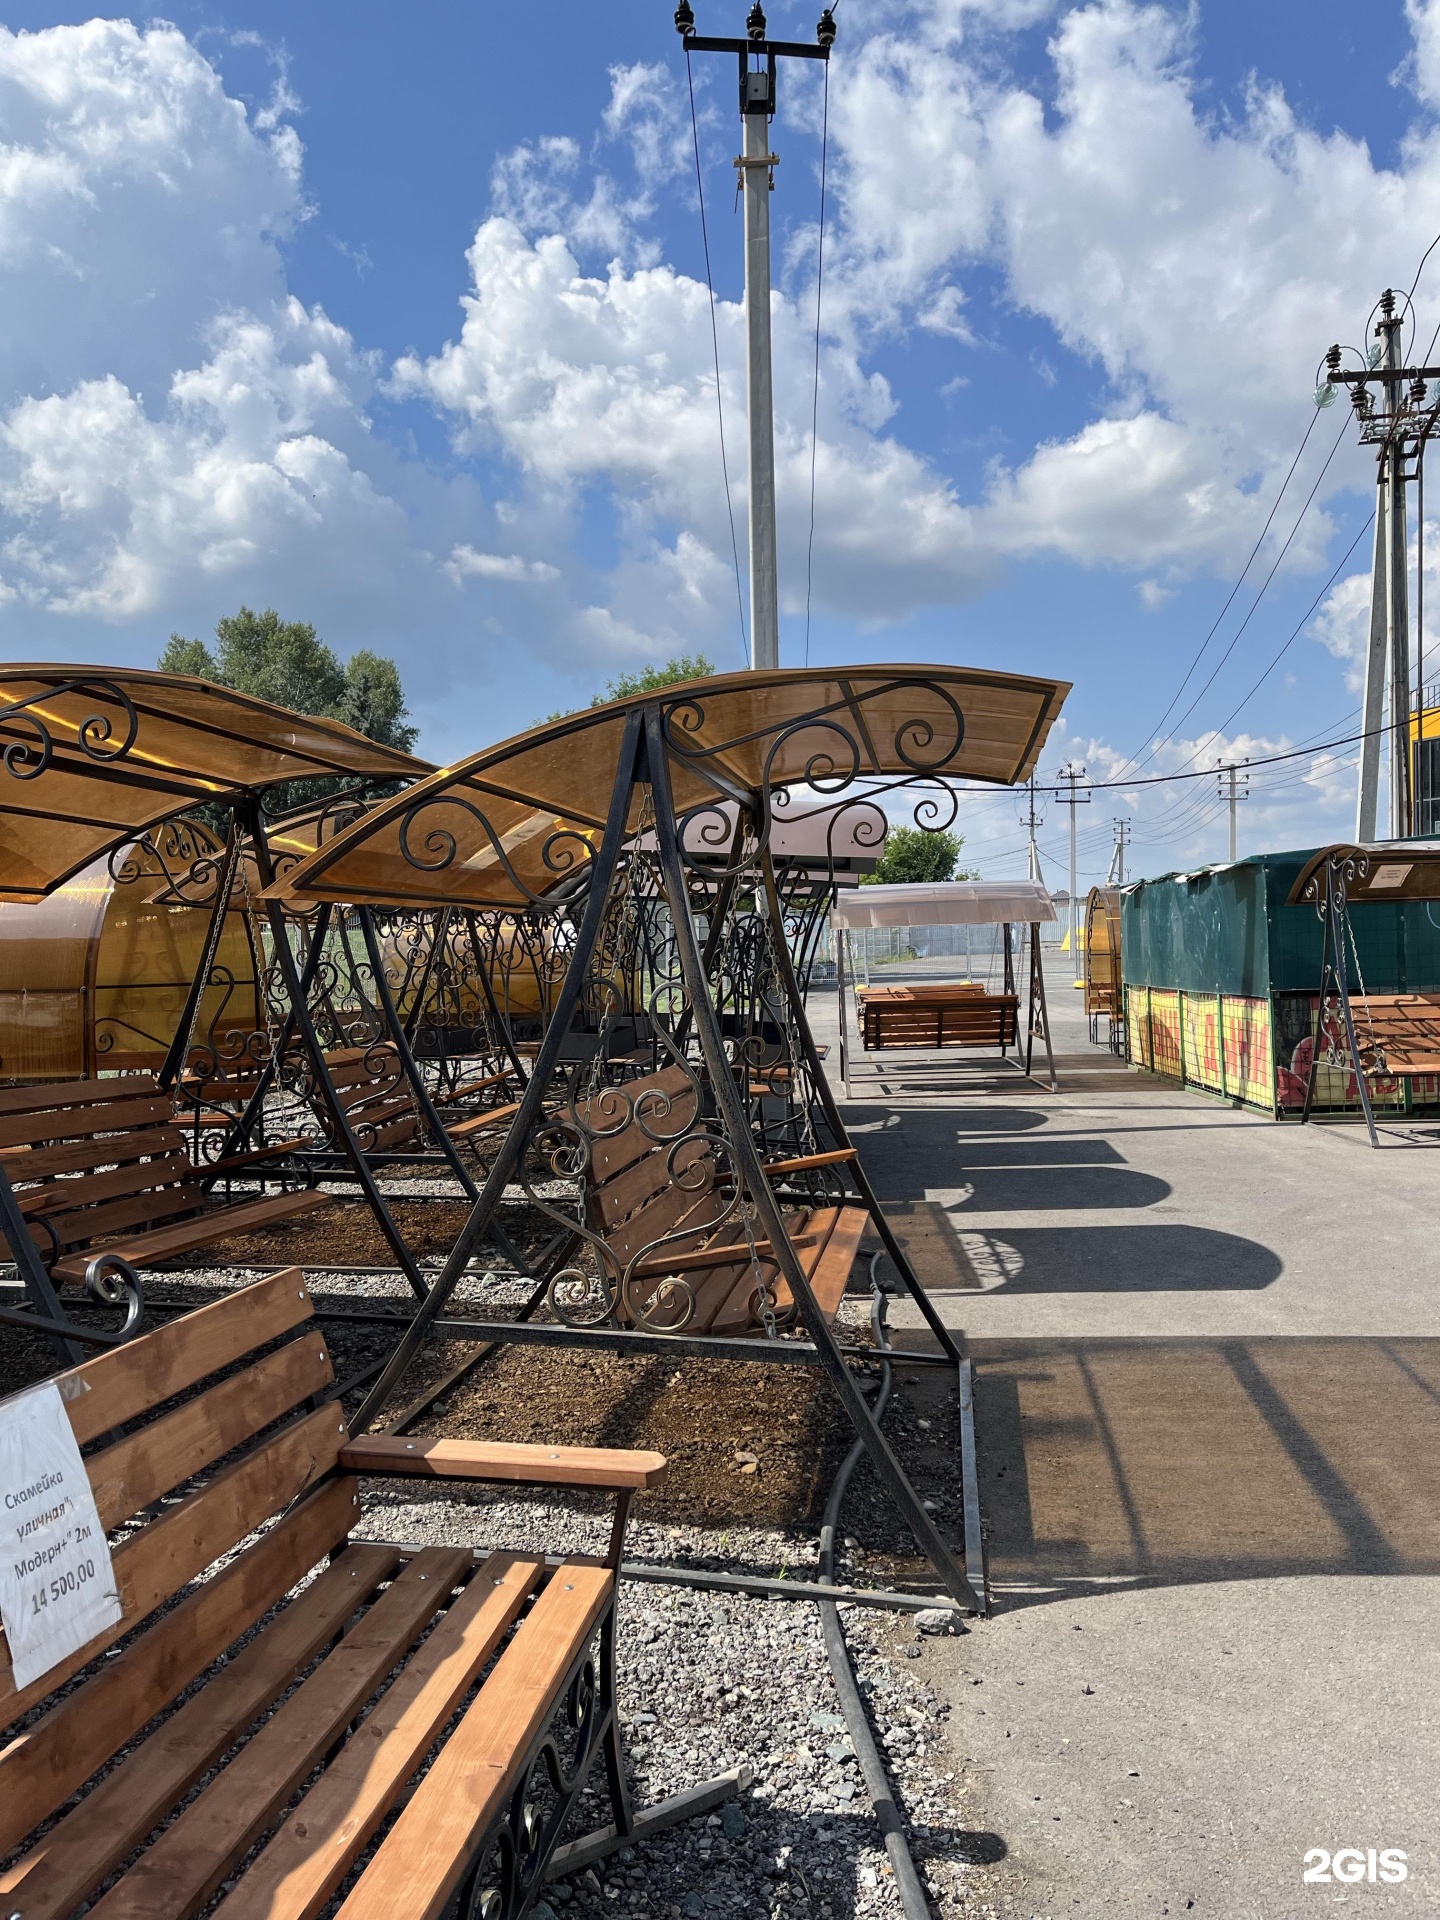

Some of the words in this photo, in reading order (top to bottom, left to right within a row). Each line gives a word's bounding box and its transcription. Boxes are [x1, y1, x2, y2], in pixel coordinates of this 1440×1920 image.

[4, 1471, 64, 1510] Скамейка
[74, 1525, 92, 1544] 2м
[31, 1588, 48, 1616] 14
[50, 1559, 95, 1602] 500,00
